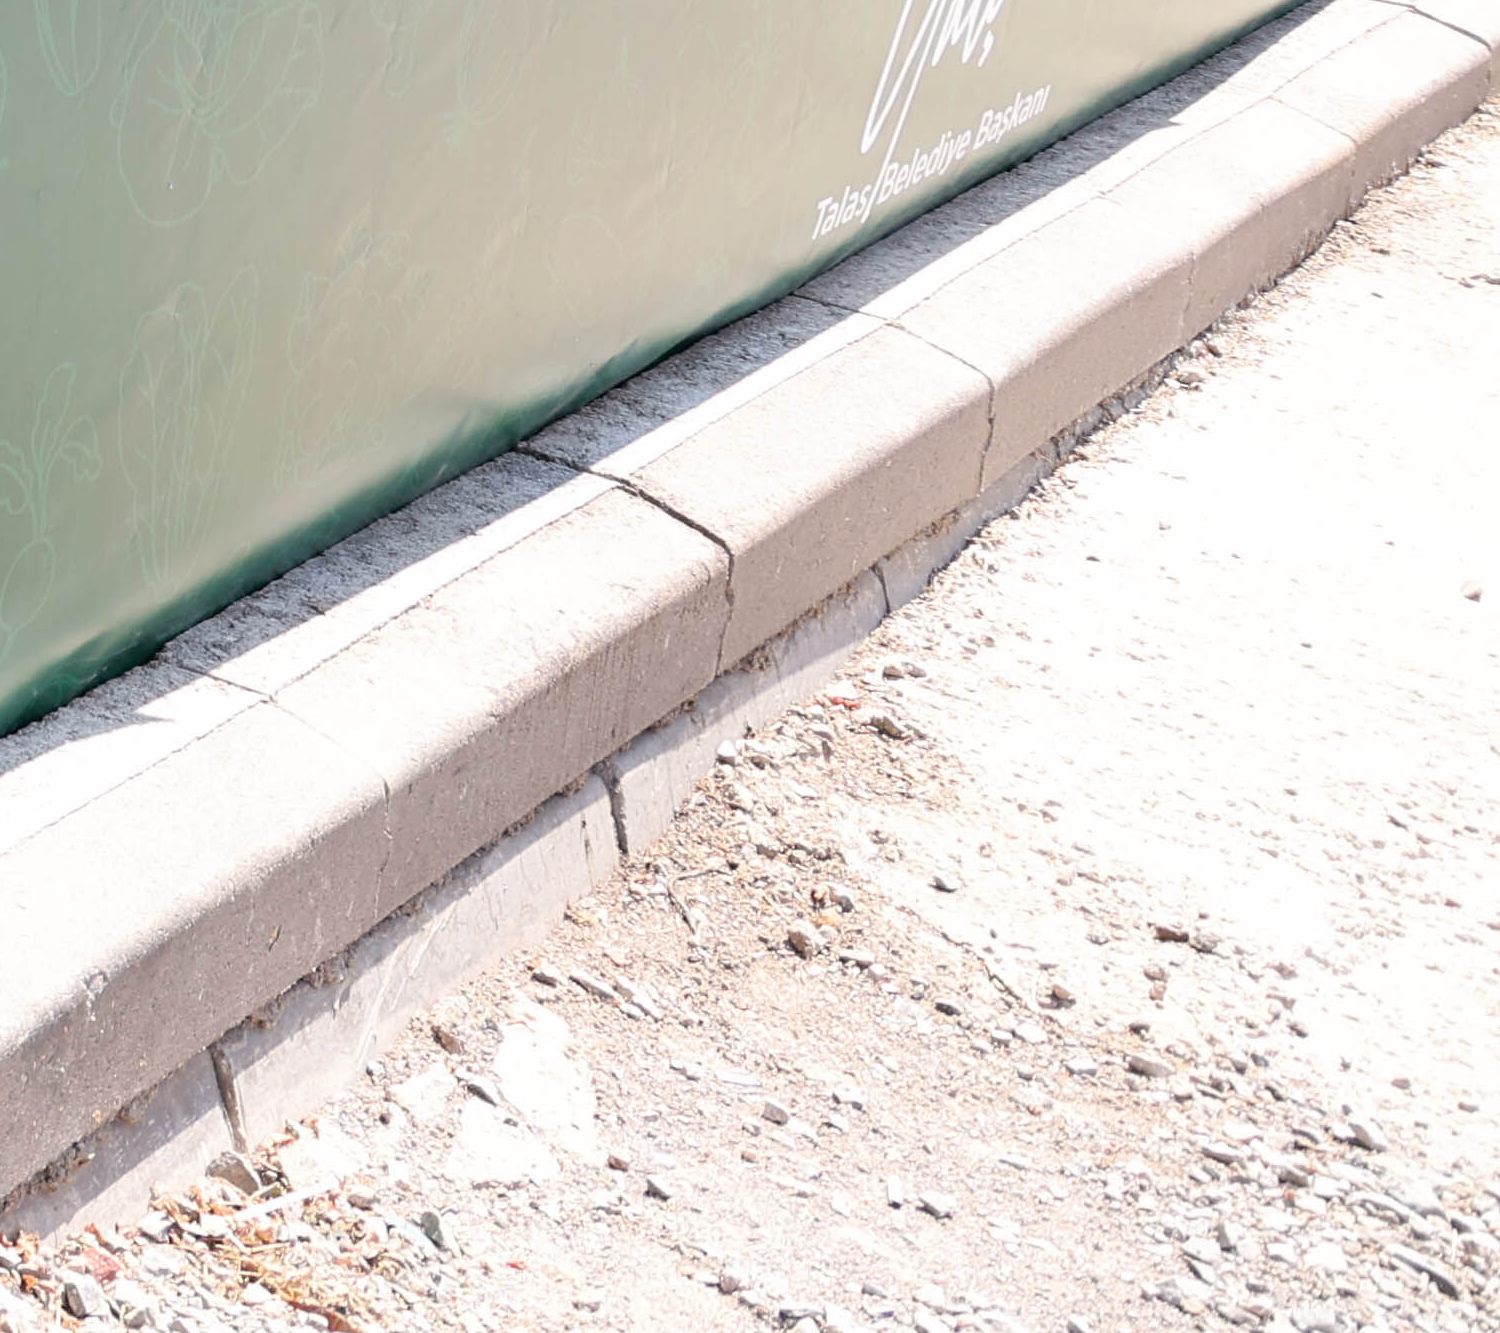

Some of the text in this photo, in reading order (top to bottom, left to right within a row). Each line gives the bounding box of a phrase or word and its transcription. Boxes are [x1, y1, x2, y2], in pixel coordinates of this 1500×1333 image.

[812, 84, 1052, 240] Talas Belediye Başkanı
